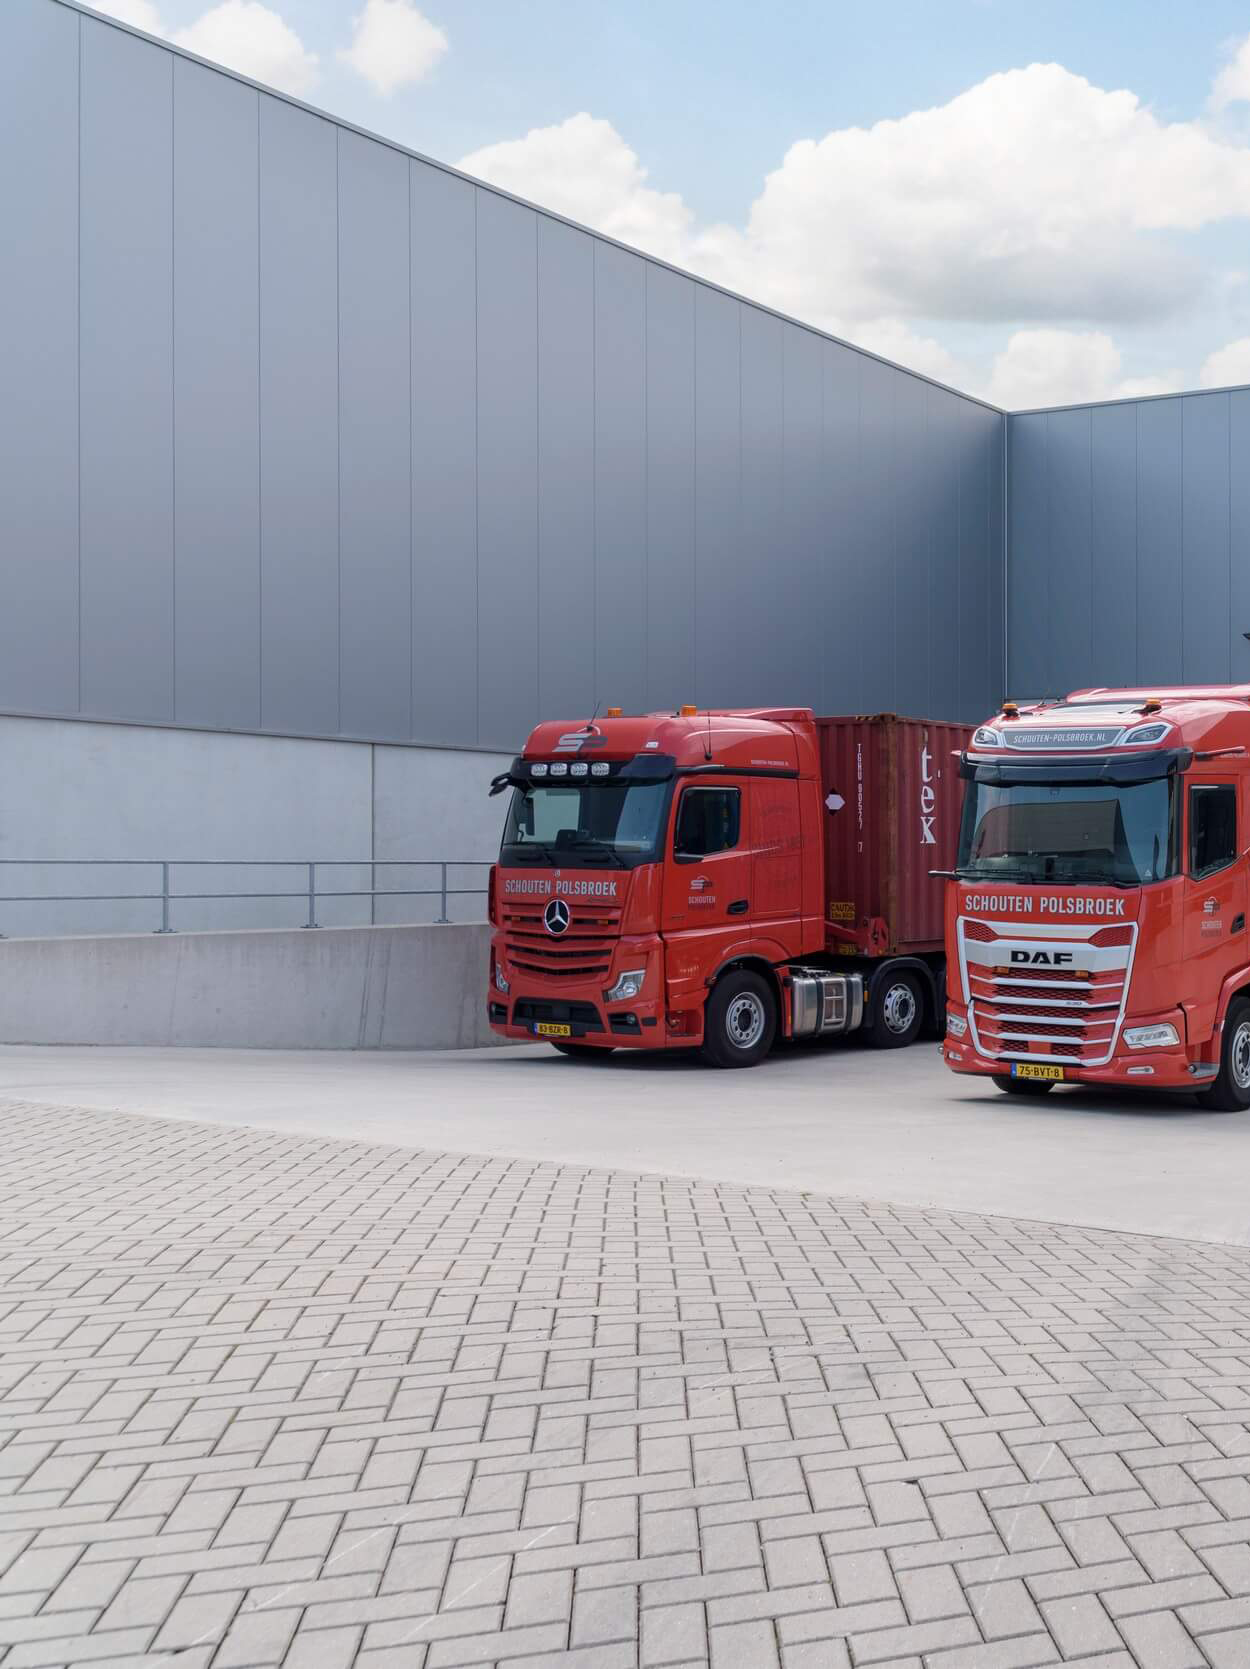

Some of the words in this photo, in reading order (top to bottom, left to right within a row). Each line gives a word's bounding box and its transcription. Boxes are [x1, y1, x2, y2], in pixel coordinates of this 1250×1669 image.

[1013, 733, 1106, 744] SCHOUTEN-POLSBROEK.NL
[920, 745, 937, 844] tex
[505, 880, 551, 894] SCHOUTEN
[556, 880, 617, 896] POLSBROEK
[965, 895, 1033, 912] SCHOUTEN
[1040, 897, 1125, 916] POLSBROEK
[1011, 950, 1073, 965] DAF
[1019, 1066, 1060, 1078] 75-BVT-8
